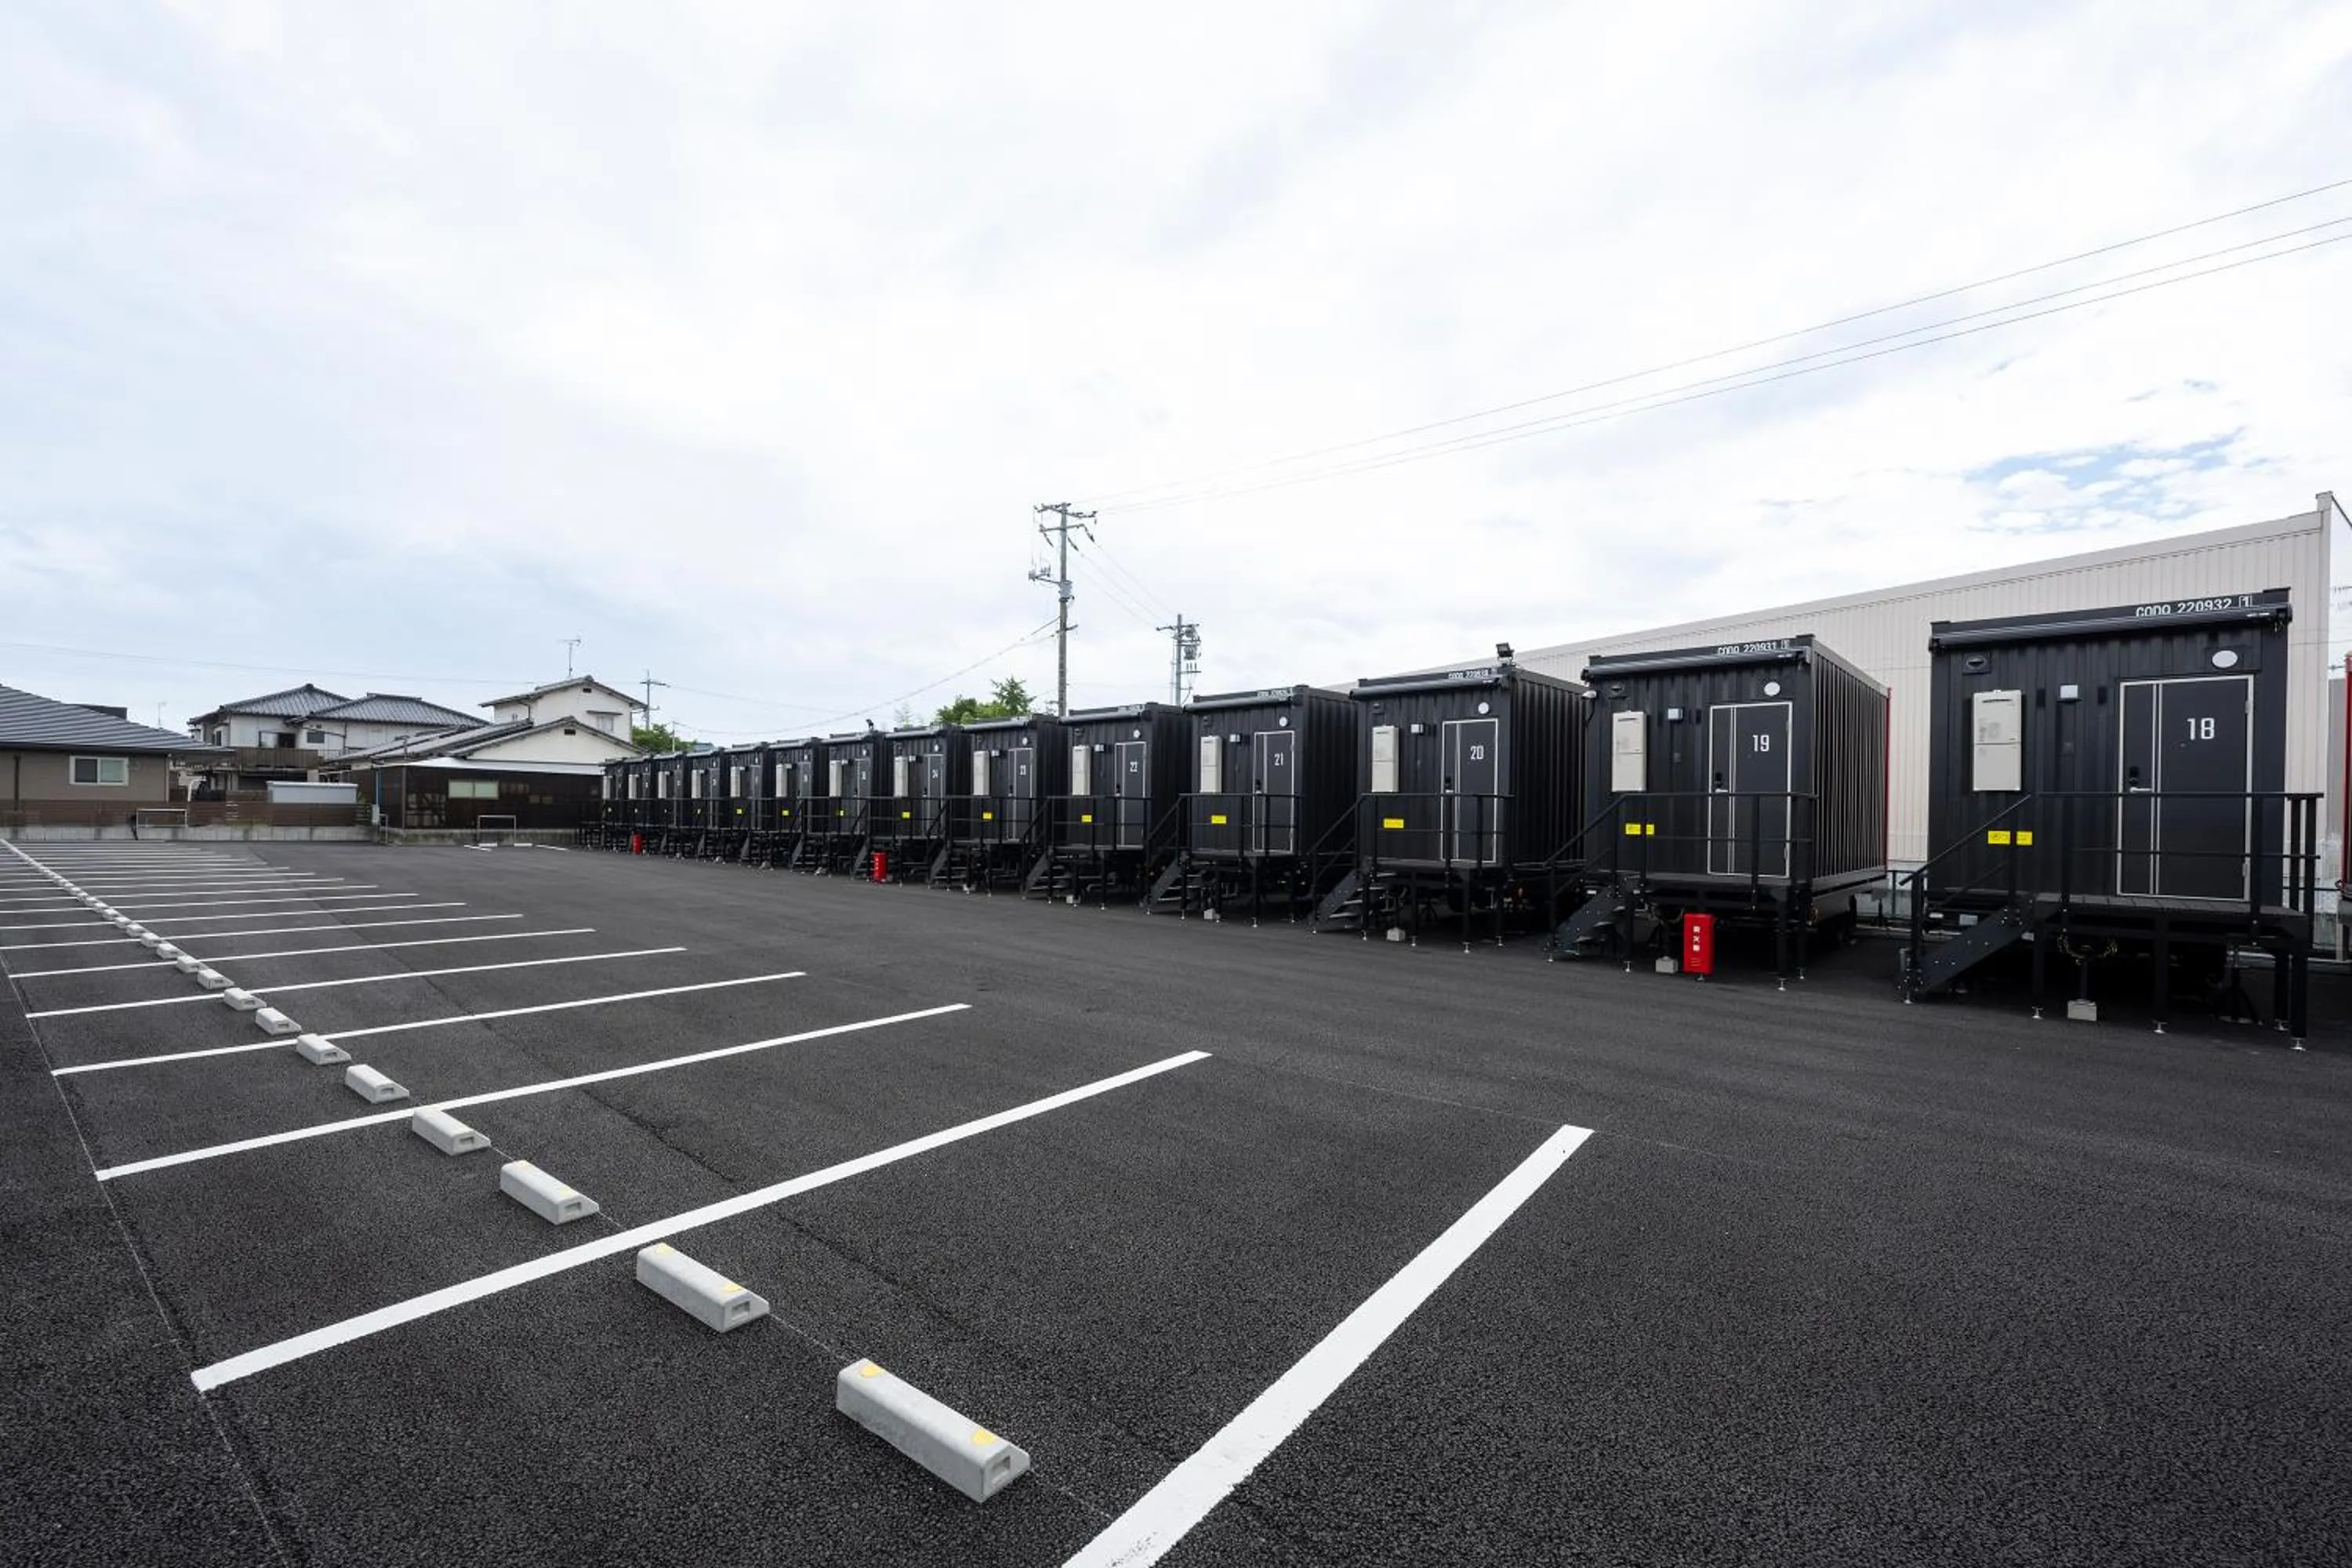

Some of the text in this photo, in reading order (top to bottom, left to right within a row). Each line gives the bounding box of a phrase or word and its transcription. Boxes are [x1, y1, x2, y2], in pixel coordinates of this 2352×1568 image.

[2177, 598, 2232, 614] 220932
[2187, 717, 2215, 741] 18
[1752, 735, 1769, 752] 19
[1274, 753, 1283, 766] 21
[1470, 745, 1484, 760] 20
